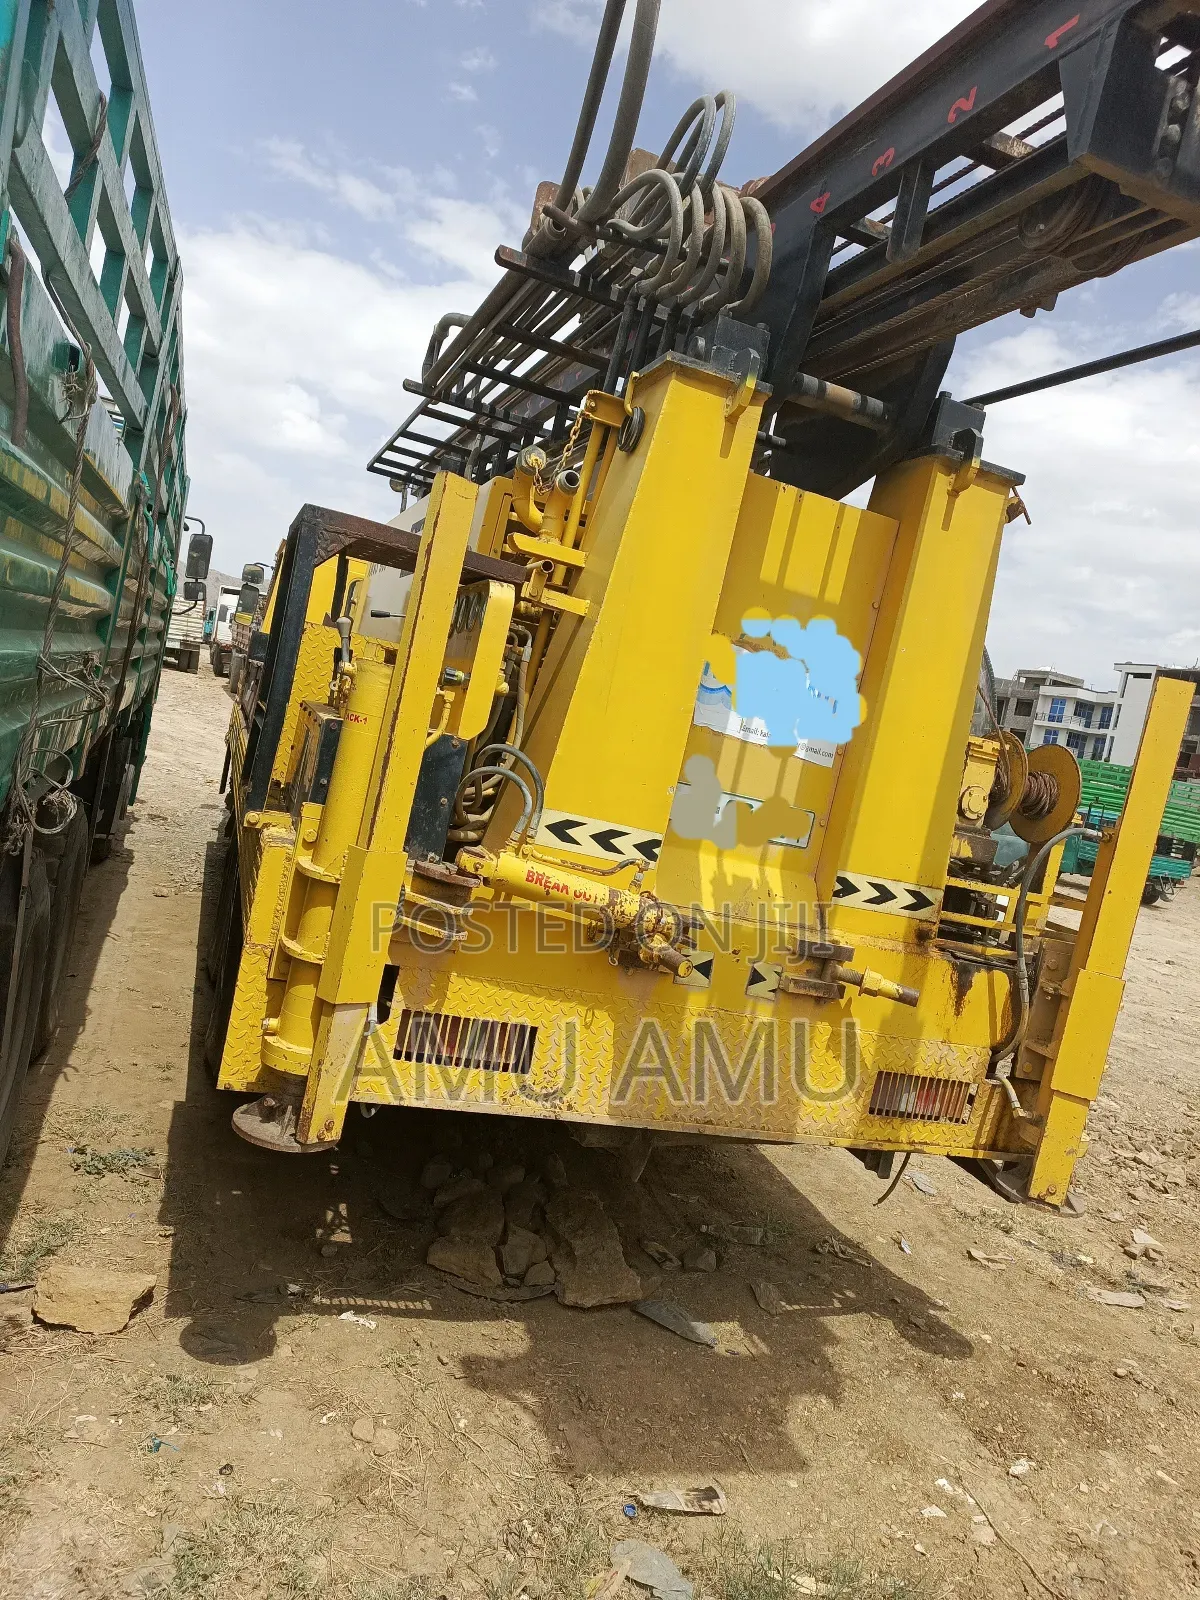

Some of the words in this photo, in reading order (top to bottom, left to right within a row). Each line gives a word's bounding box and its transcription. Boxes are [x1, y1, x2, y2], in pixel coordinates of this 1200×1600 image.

[947, 86, 977, 123] 2
[871, 147, 895, 177] 3
[346, 712, 368, 725] ACK-1
